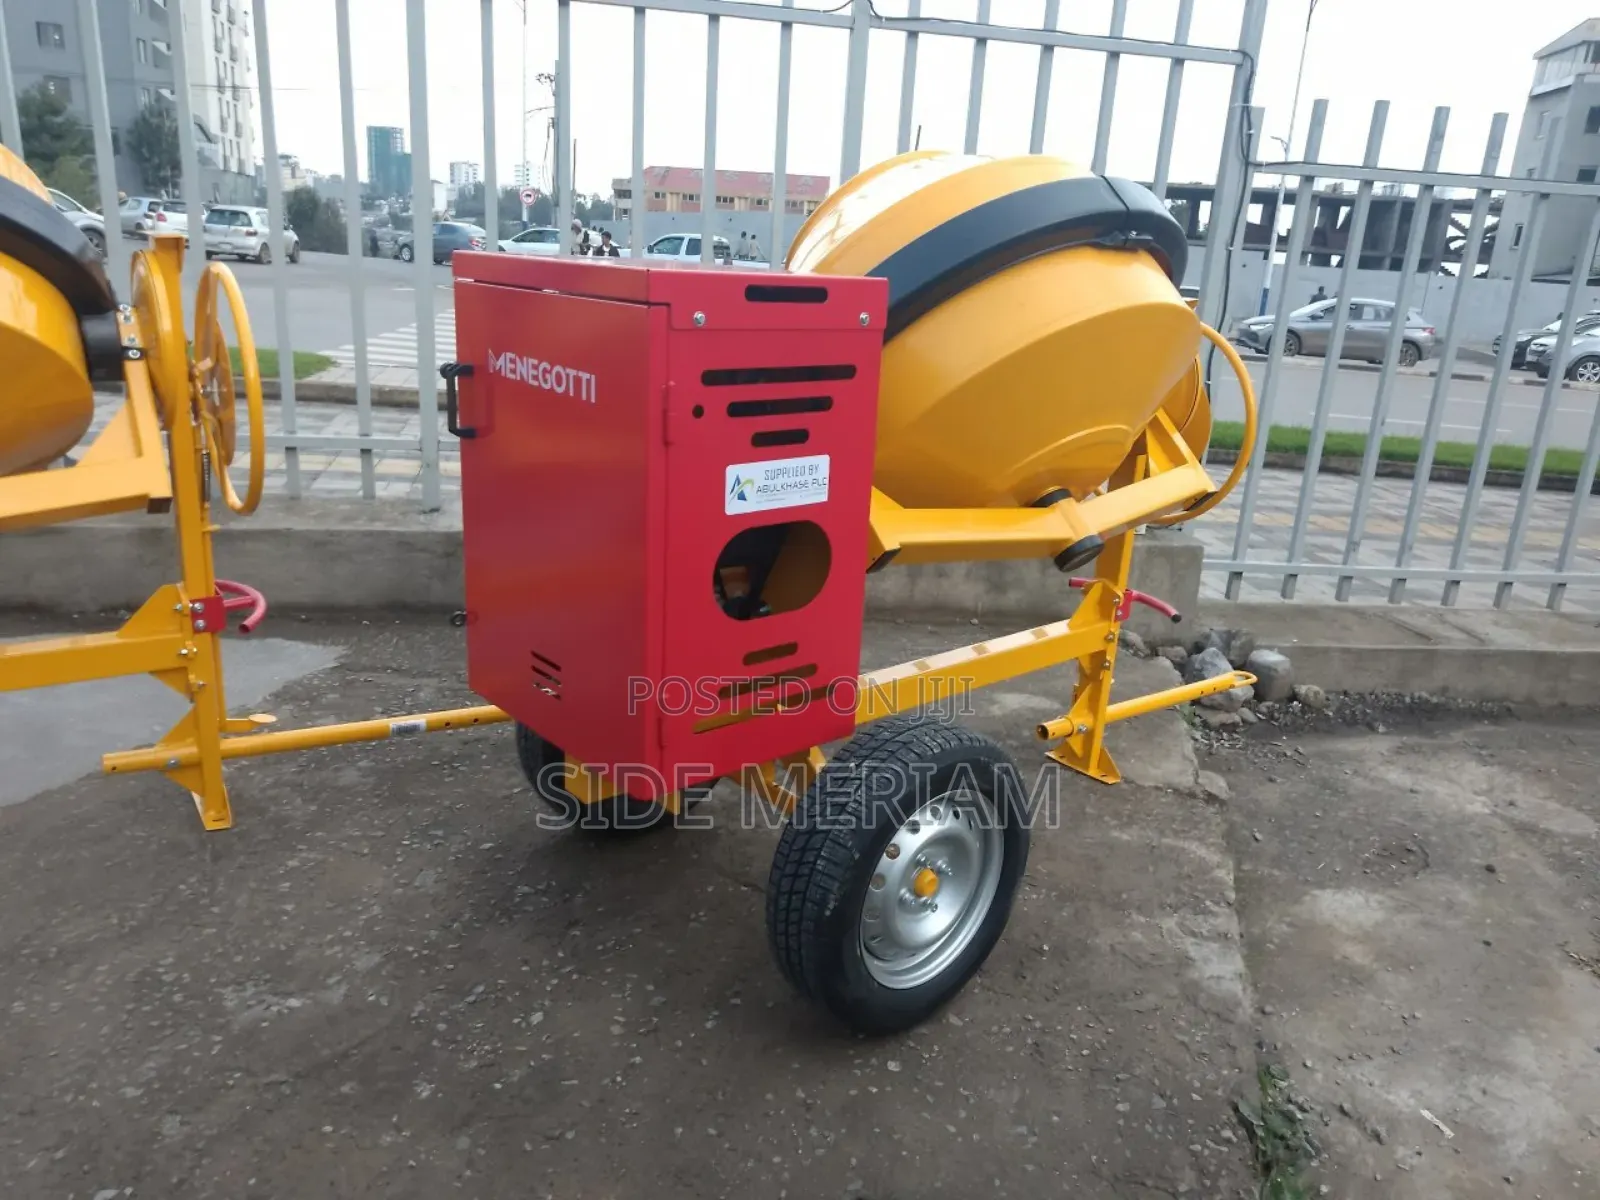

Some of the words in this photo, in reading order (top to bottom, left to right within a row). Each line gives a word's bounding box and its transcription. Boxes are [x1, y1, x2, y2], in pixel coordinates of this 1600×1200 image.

[488, 348, 596, 403] MENEGOTTI
[764, 465, 806, 480] SUPPLIED
[808, 463, 820, 476] BY
[756, 479, 809, 494] ABULKHASE
